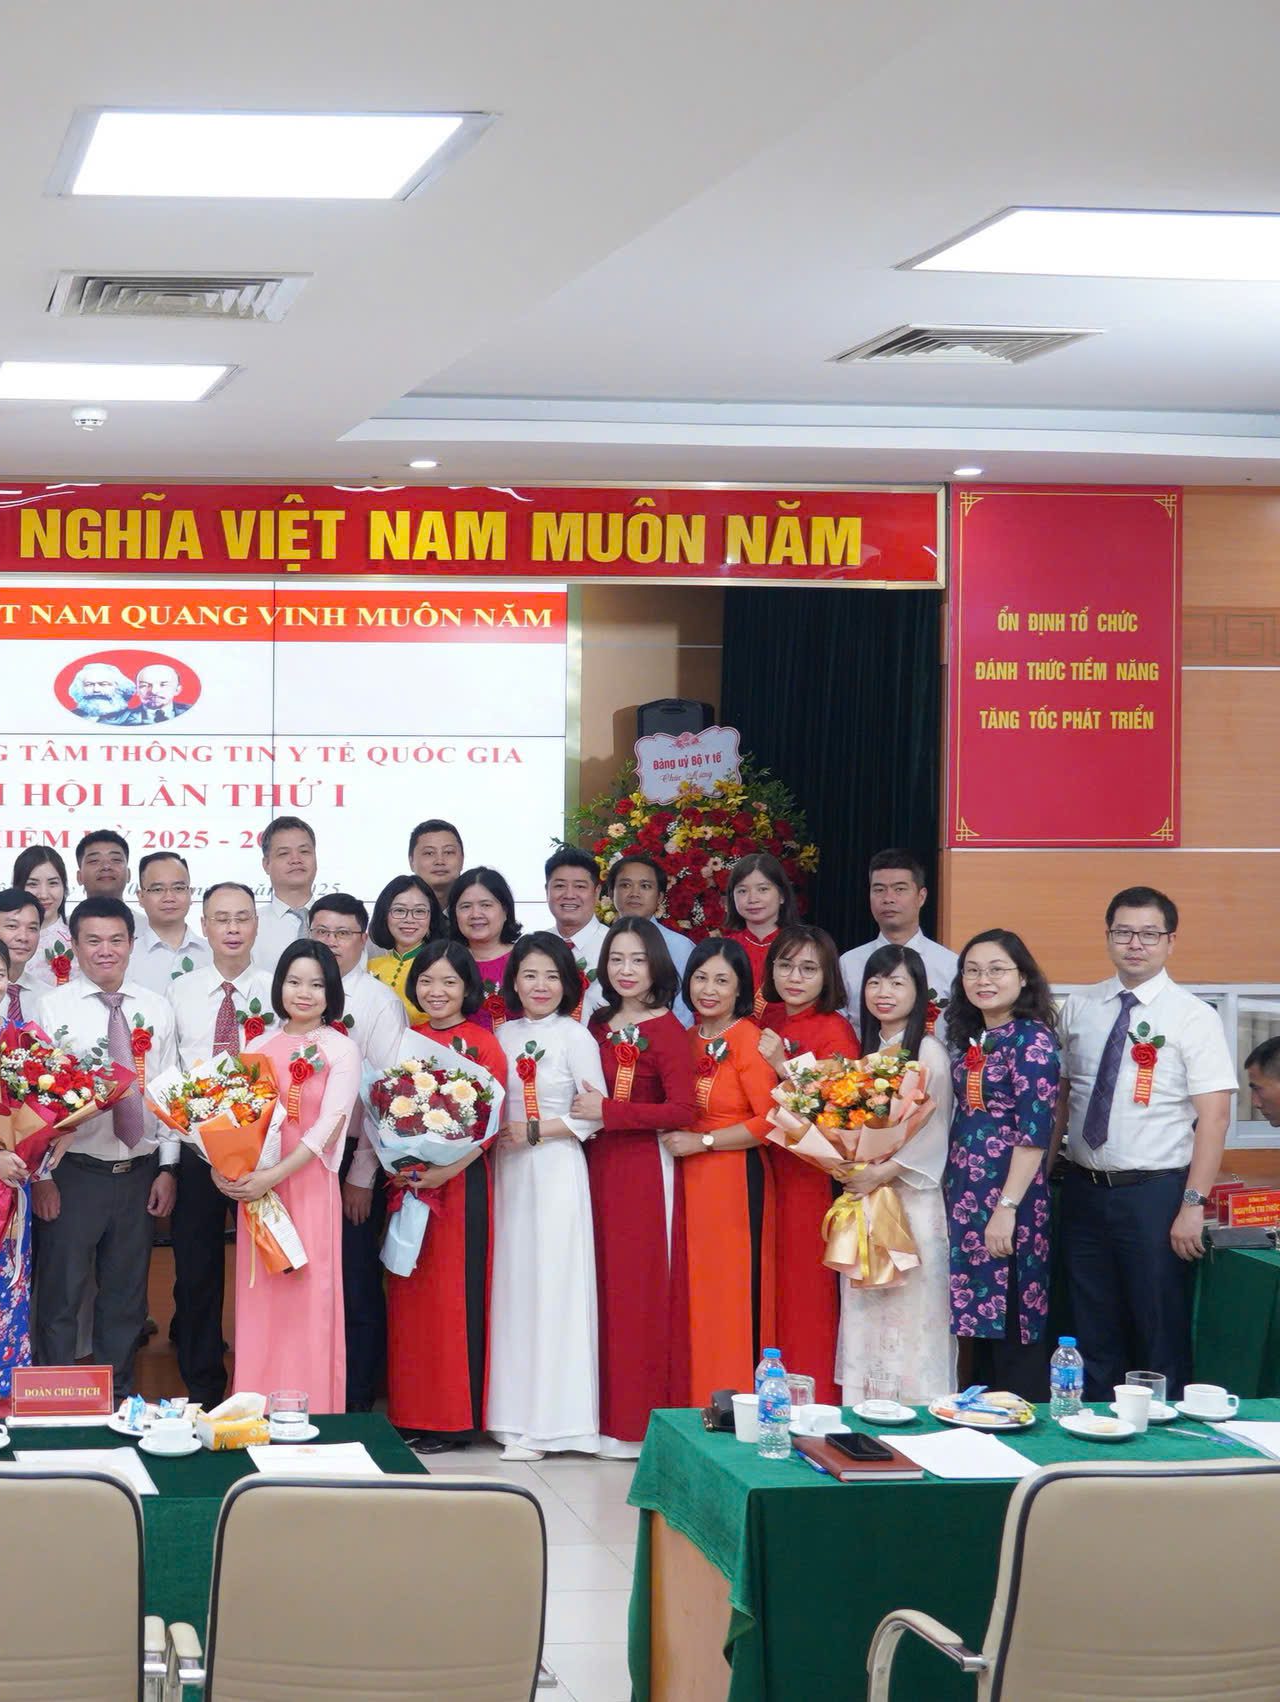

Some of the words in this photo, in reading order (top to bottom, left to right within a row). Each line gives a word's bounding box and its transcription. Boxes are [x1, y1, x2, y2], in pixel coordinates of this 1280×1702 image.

[21, 492, 203, 560] NGHĨA
[220, 494, 345, 571] VIỆT
[369, 510, 507, 561] NAM
[532, 497, 705, 565] MUÔN
[725, 499, 862, 566] NĂM
[29, 604, 111, 625] NAM
[121, 605, 249, 629] QUANG
[258, 607, 347, 627] VINH
[356, 601, 462, 628] MUÔN
[472, 603, 552, 628] NĂM
[997, 605, 1020, 632] ỔN
[1028, 613, 1065, 636] ĐỊNH
[1070, 606, 1088, 632] TỔ
[1097, 608, 1138, 632] CHỨC
[975, 657, 1018, 682] ĐÁNH
[1027, 657, 1065, 681] THỨC
[1070, 656, 1107, 681] TIỀM
[1116, 658, 1159, 682] NĂNG
[979, 707, 1020, 730] TĂNG
[1029, 704, 1057, 730] TỐC
[1062, 706, 1101, 730] PHÁT
[1110, 703, 1154, 730] TRIỂN
[19, 741, 88, 762] TÂM
[100, 741, 212, 763] THÔNG
[224, 745, 276, 763] TIN
[288, 746, 308, 763] Y
[467, 746, 524, 764] GIA
[23, 779, 111, 813] HỘI
[120, 775, 209, 807] LẦN
[222, 776, 323, 808] THỨ
[334, 783, 347, 808] I
[143, 829, 209, 849] 2025
